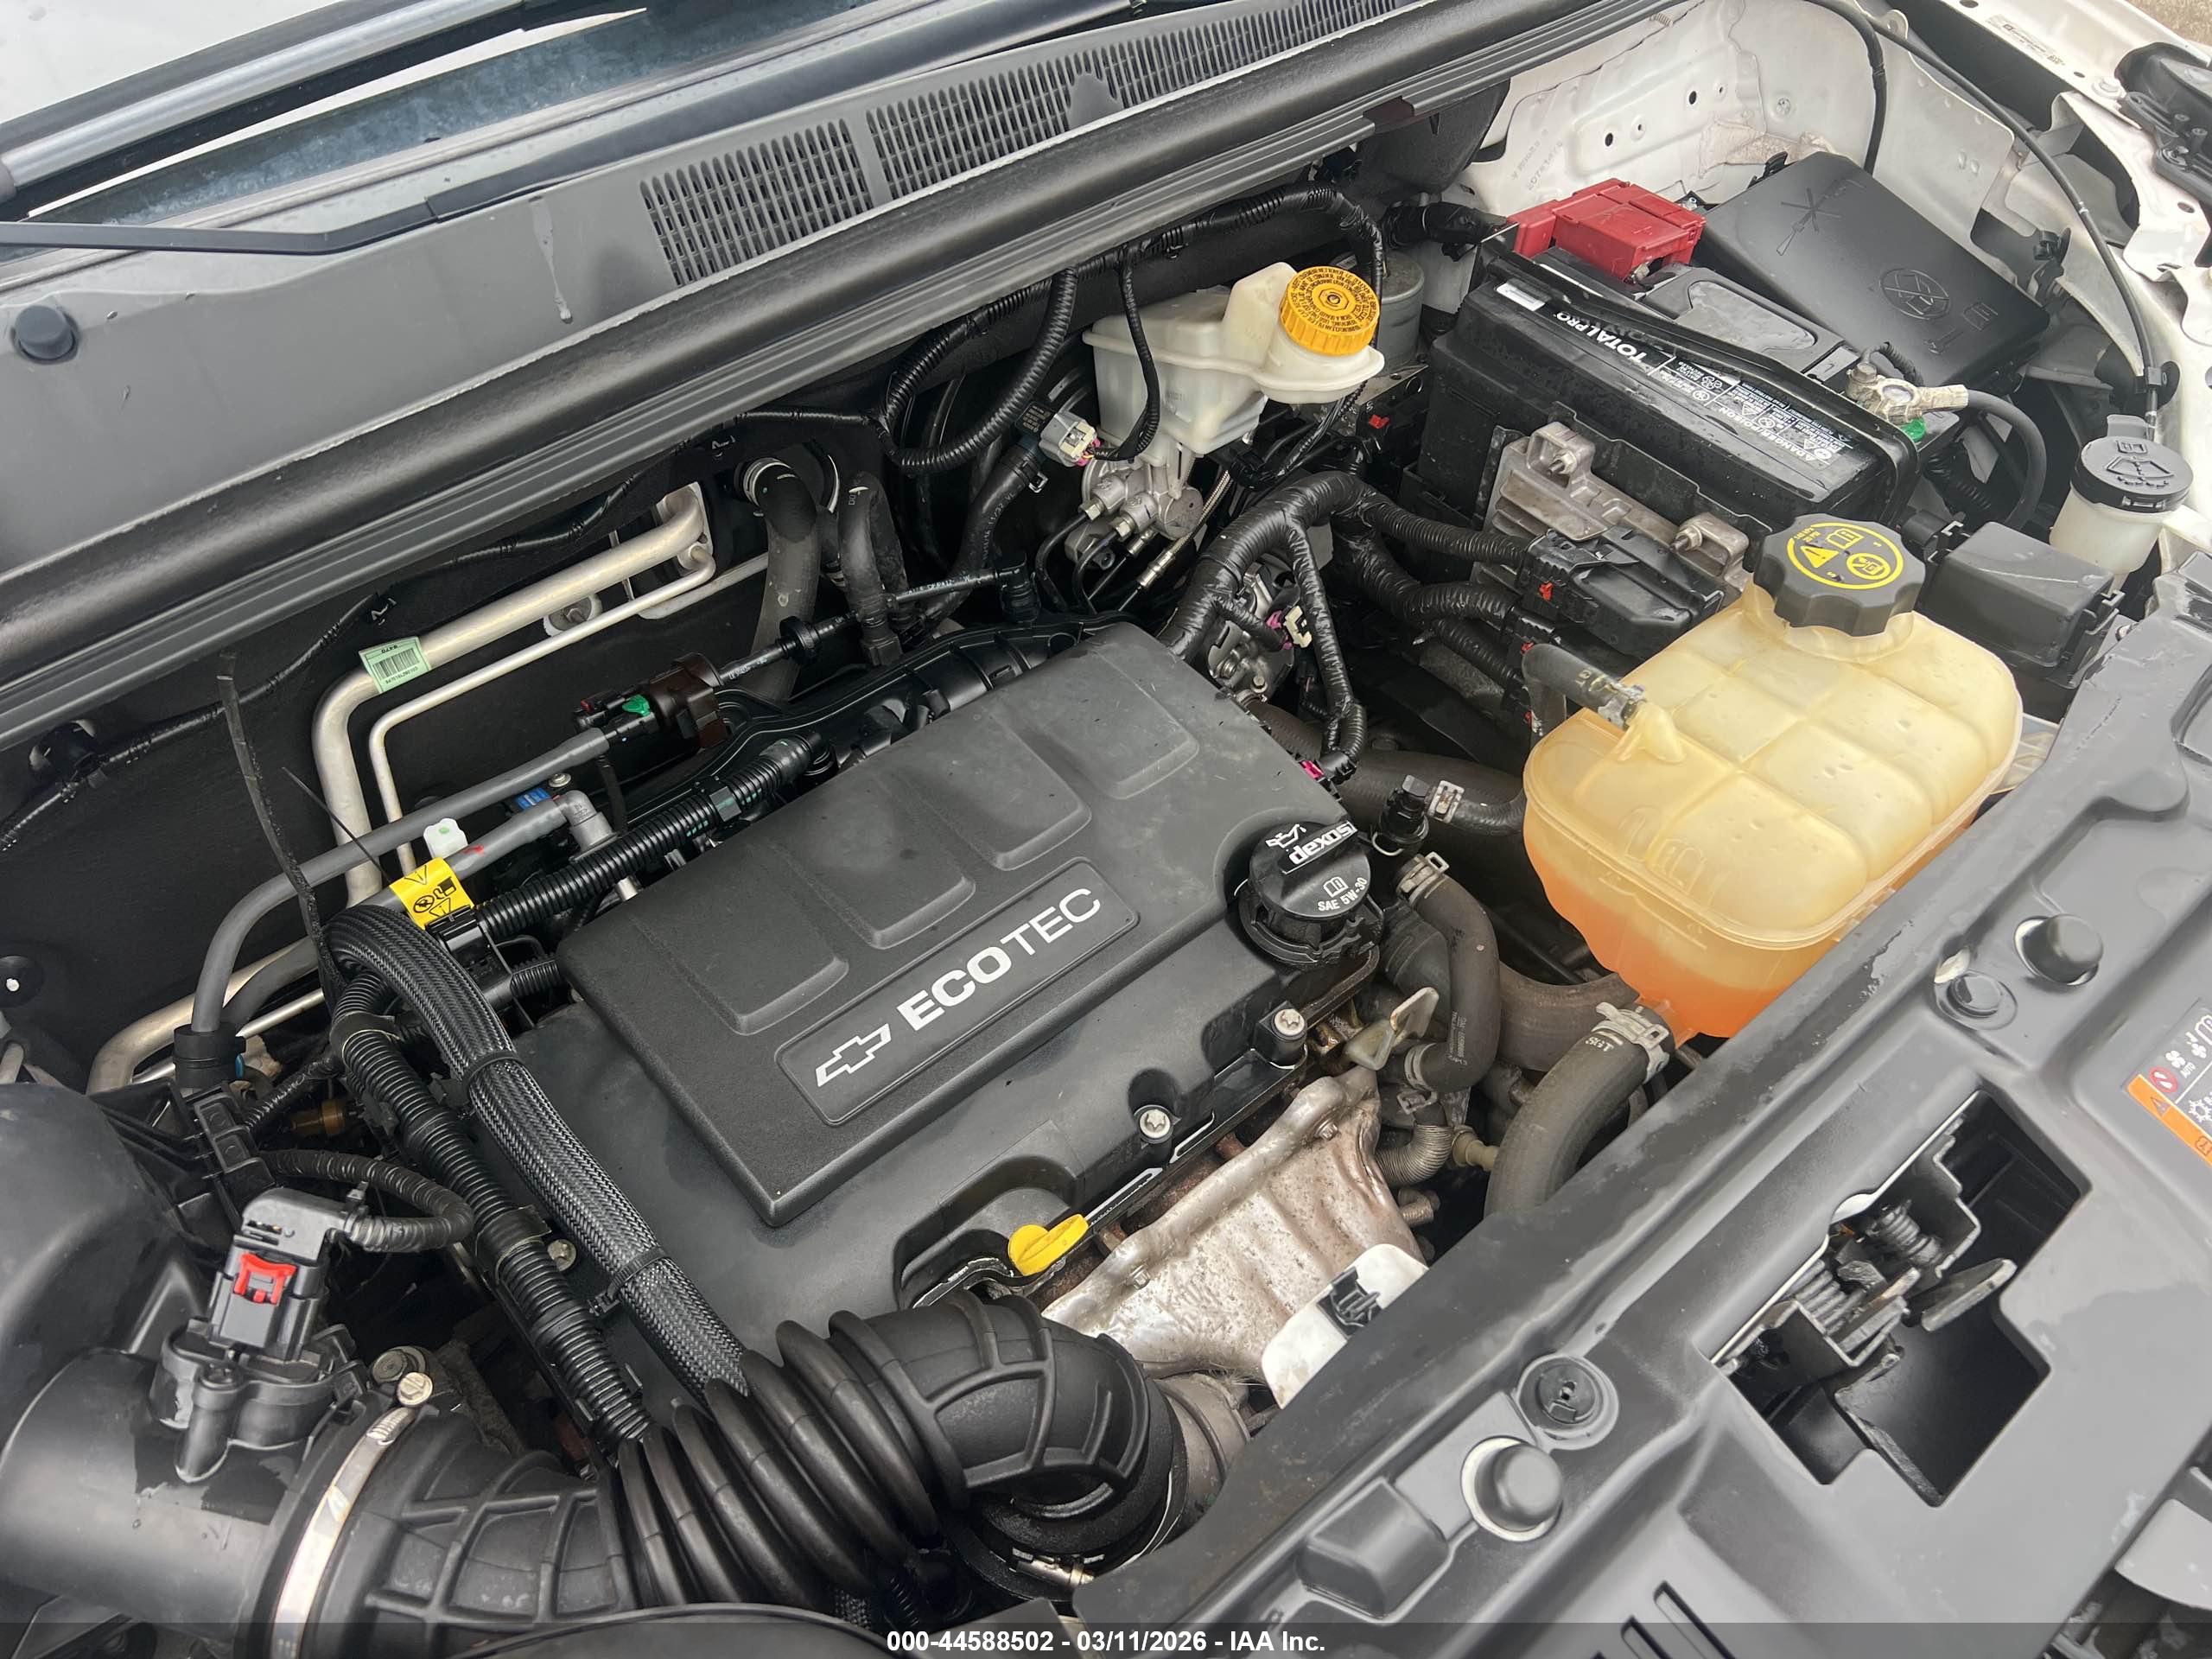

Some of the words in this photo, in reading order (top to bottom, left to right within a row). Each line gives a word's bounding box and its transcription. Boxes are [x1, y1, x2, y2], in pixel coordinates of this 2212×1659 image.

[1318, 898, 1340, 912] SAE
[1339, 877, 1368, 906] 5W-30
[897, 887, 1102, 1032] ECOTEC
